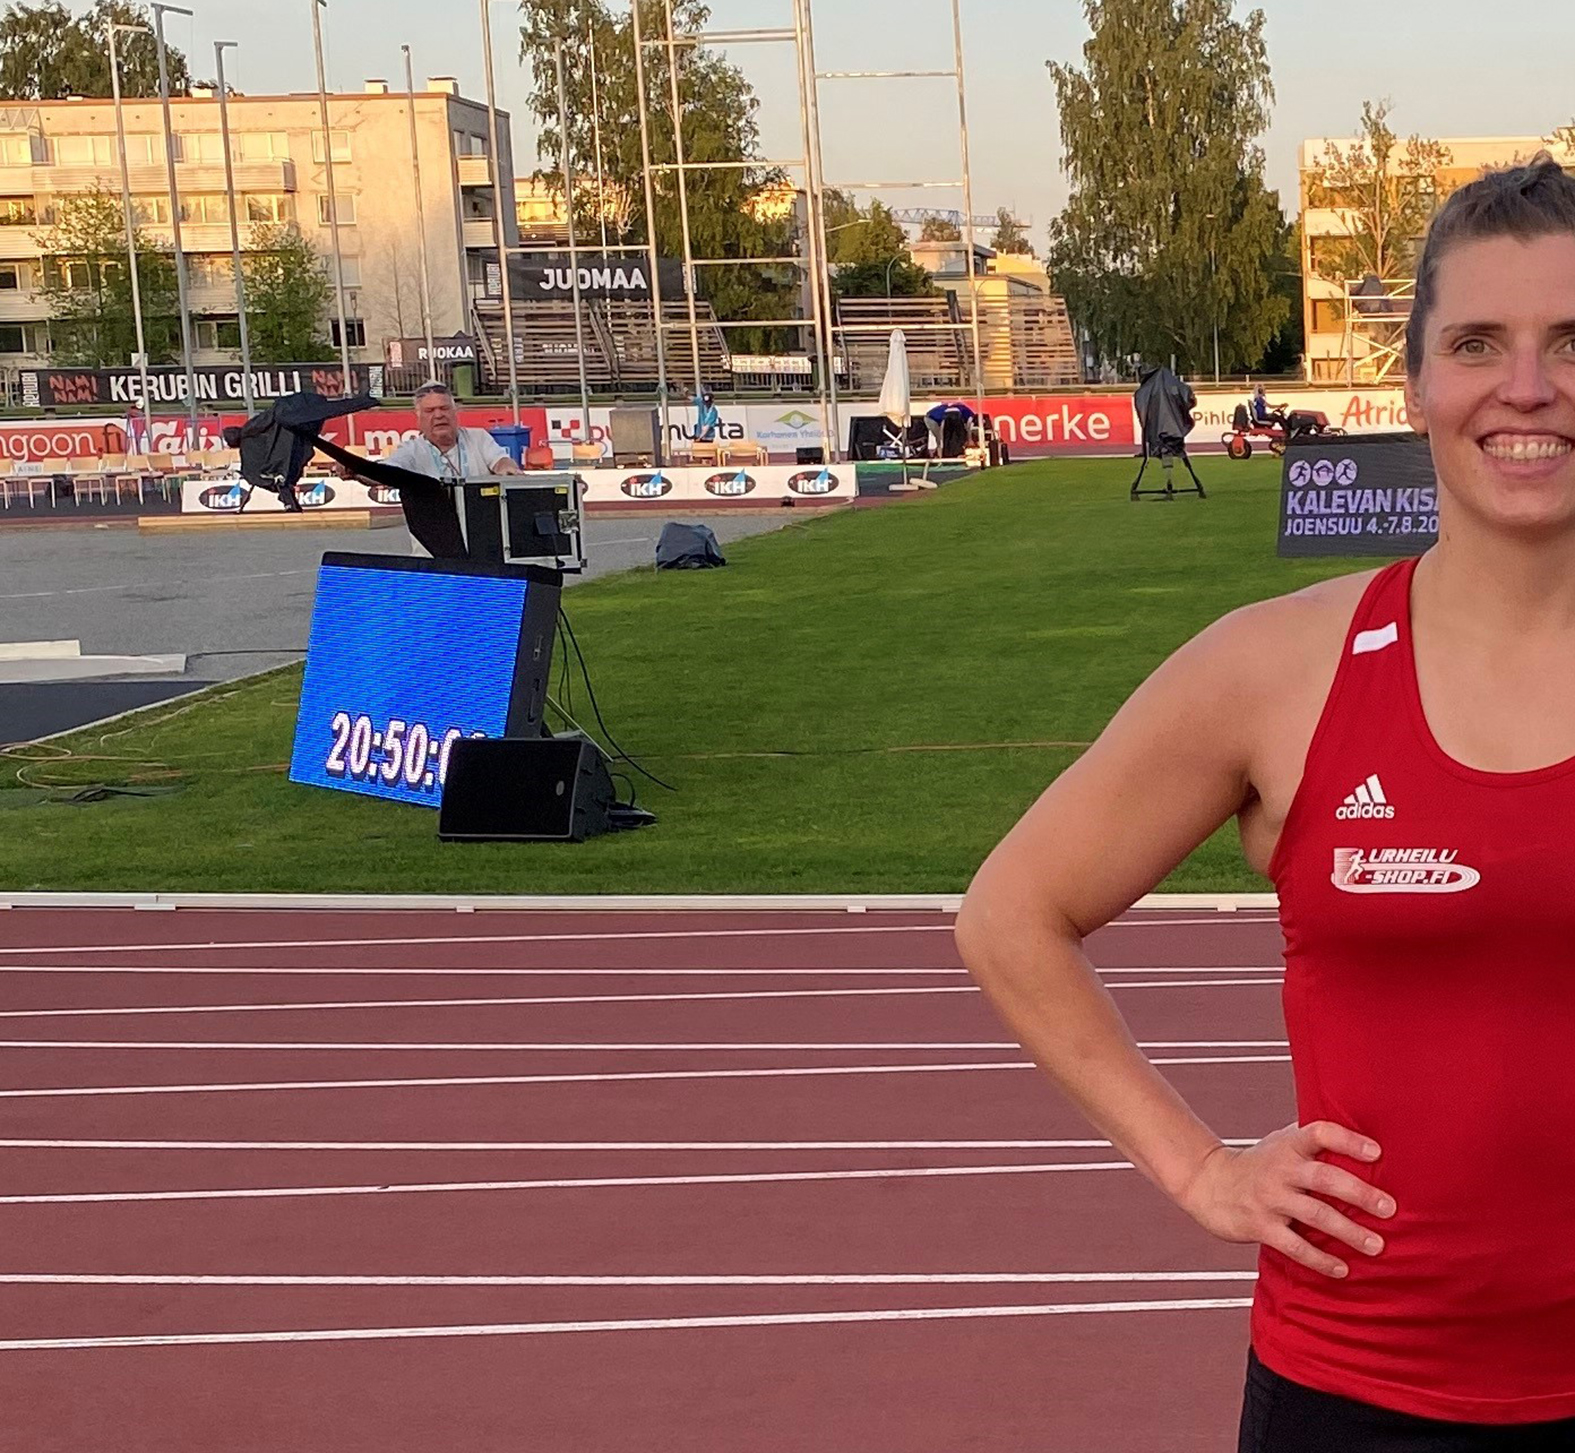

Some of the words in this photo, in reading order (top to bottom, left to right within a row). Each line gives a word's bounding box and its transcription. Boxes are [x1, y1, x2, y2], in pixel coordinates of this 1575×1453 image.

[539, 267, 648, 291] JUOMAA
[110, 372, 218, 402] KERUBIN
[224, 370, 302, 399] GRILLI
[1286, 488, 1393, 515] KALEVAN
[1396, 487, 1440, 513] KIS
[1285, 517, 1362, 536] JOENSUU
[1335, 801, 1395, 820] adidas
[1368, 848, 1459, 863] URHEILU
